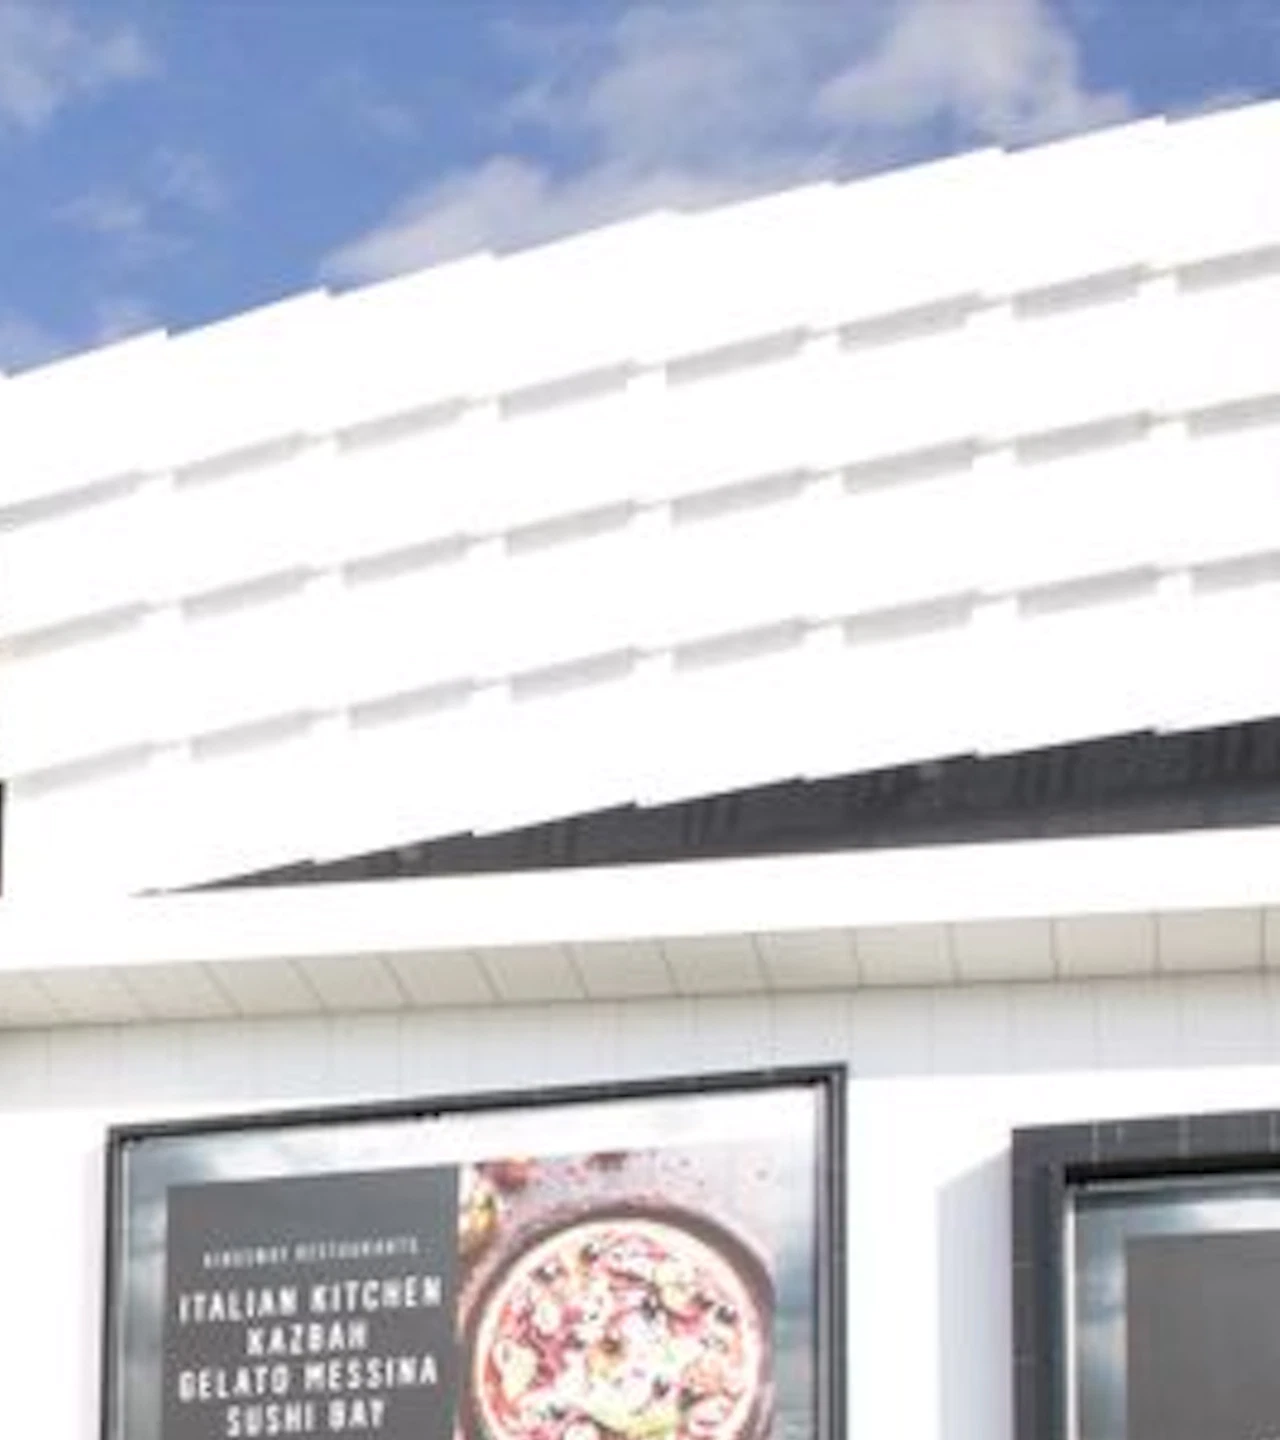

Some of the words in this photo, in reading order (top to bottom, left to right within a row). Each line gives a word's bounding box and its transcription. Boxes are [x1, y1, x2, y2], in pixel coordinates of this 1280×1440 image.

[178, 1286, 298, 1323] ITALIAN
[310, 1276, 443, 1313] KITCHEN
[246, 1320, 369, 1355] KAZBAH
[178, 1364, 290, 1403] GELATO
[304, 1355, 438, 1393] MESSINA
[227, 1402, 314, 1437] SUSHI
[328, 1400, 386, 1431] BAY
